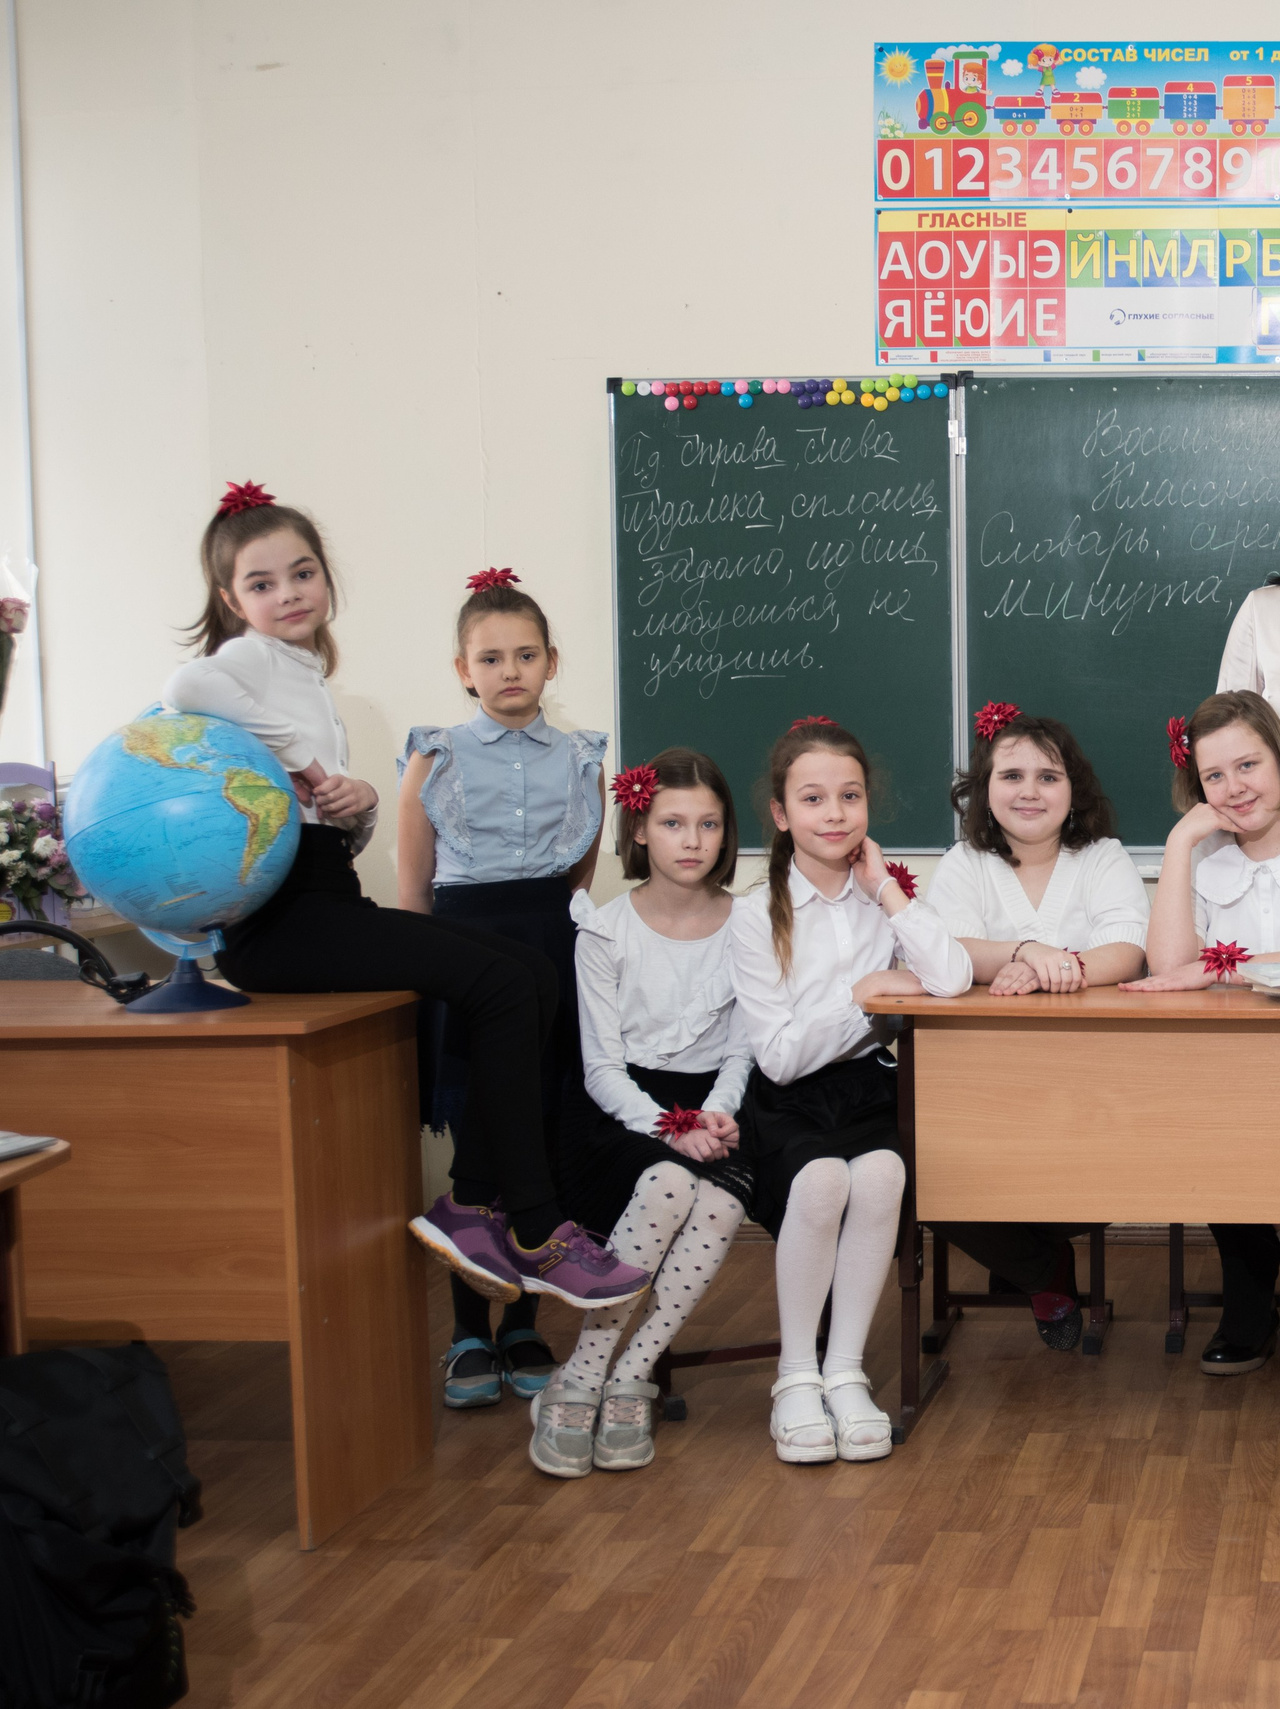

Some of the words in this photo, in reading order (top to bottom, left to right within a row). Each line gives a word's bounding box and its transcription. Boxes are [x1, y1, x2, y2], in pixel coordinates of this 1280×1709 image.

[1060, 47, 1138, 62] СОСТАВ
[1144, 47, 1209, 62] ЧИСЕЛ
[1229, 50, 1250, 62] от
[1255, 48, 1264, 61] 1
[1186, 83, 1194, 92] 4
[1245, 76, 1253, 86] 5
[1073, 93, 1080, 102] 2
[1130, 88, 1137, 97] 3
[882, 149, 910, 191] 0
[924, 148, 943, 190] 1
[957, 147, 985, 190] 2
[995, 147, 1023, 190] 3
[1031, 147, 1062, 191] 4
[1070, 147, 1098, 190] 5
[1107, 146, 1137, 190] 6
[1141, 147, 1174, 190] 7
[1183, 146, 1214, 190] 8
[1222, 146, 1253, 190] 9
[917, 212, 1027, 229] ГЛАСНЫЕ
[879, 241, 914, 280] А
[918, 240, 950, 280] О
[956, 239, 988, 279] У
[994, 239, 1025, 278] Ы
[1033, 239, 1061, 278] Э
[1070, 233, 1101, 280] Й
[1107, 239, 1137, 278] Н
[1142, 239, 1177, 277] М
[1182, 239, 1215, 278] Л
[1225, 239, 1252, 278] Р
[884, 299, 911, 338] Я
[923, 291, 946, 338] Ё
[954, 299, 989, 338] Ю
[995, 299, 1025, 338] И
[1036, 299, 1058, 338] Е
[1128, 312, 1160, 322] ГЛУХИЕ
[1162, 312, 1215, 322] СОГЛАСНЫЕ
[869, 589, 915, 621] не
